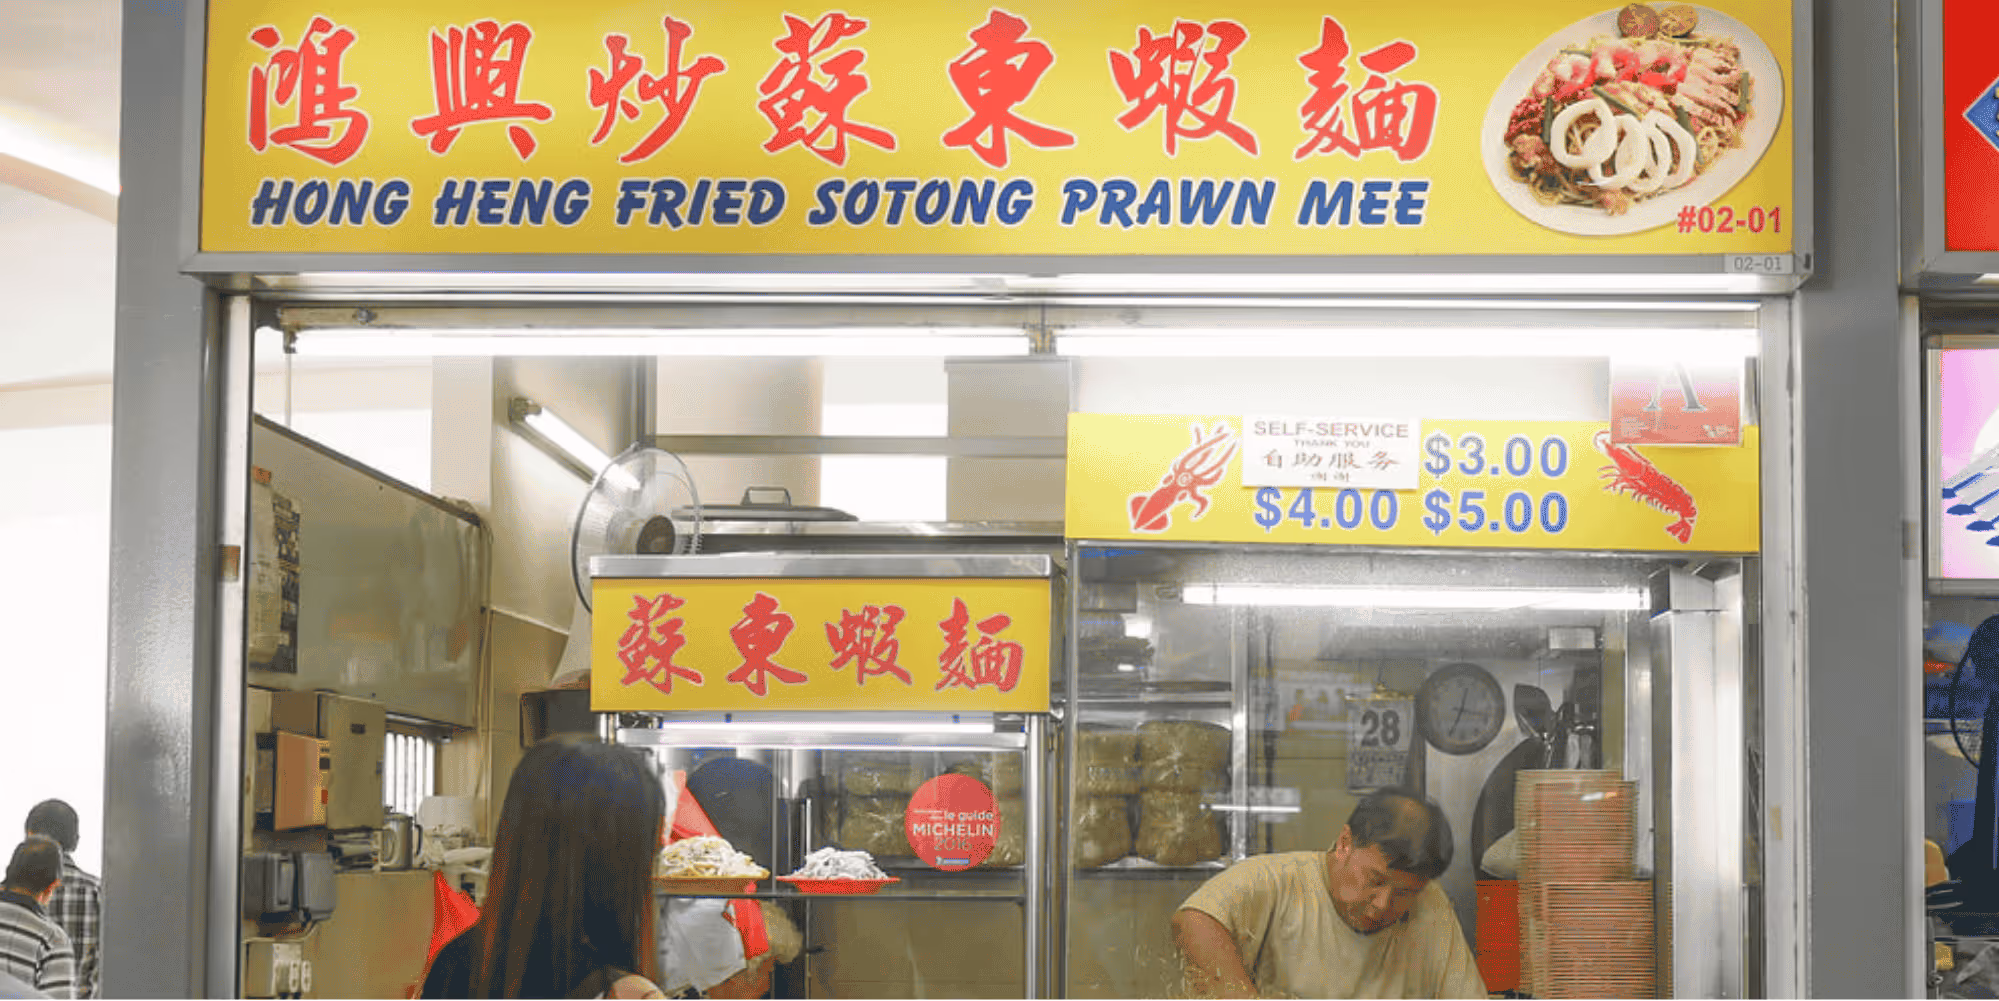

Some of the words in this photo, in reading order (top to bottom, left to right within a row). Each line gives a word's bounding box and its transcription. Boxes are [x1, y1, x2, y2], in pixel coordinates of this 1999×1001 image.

[251, 180, 410, 226] HONG
[434, 180, 592, 226] HENG
[616, 180, 785, 228] FRIED
[809, 180, 1033, 226] SOTONG
[1061, 180, 1276, 228] PRAWN
[1298, 180, 1430, 226] MEE
[1677, 205, 1781, 233] #02-01
[1734, 256, 1782, 271] 02-01
[1254, 420, 1409, 438] SELF-SERVICE
[1294, 439, 1337, 448] THANK
[1344, 440, 1370, 448] YOU
[1263, 449, 1401, 471] 自助服务
[1423, 433, 1568, 479] $3.00
[1254, 486, 1399, 533] $4.00
[1423, 489, 1568, 536] $5.00
[617, 592, 1024, 697] 蘇東蝦麵
[1360, 709, 1400, 746] 28
[958, 810, 994, 821] guide
[912, 823, 994, 836] MICHELIN
[934, 836, 972, 851] 2016
